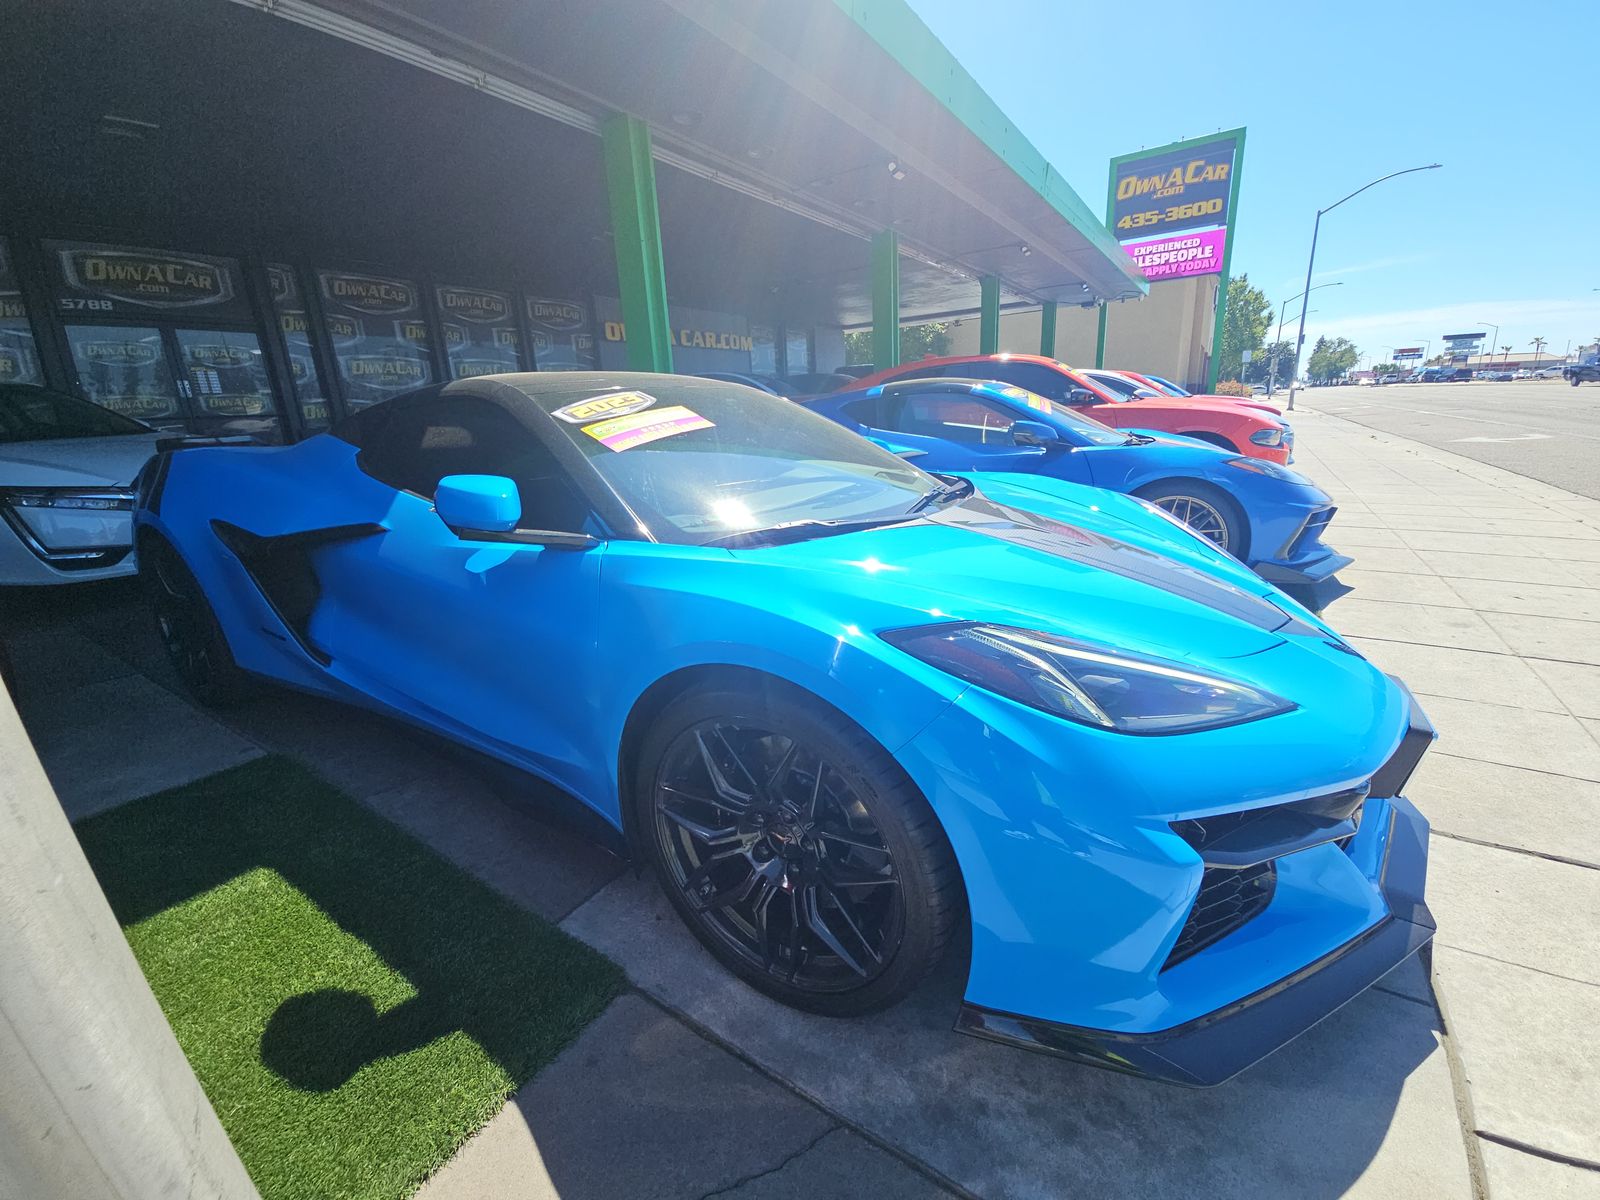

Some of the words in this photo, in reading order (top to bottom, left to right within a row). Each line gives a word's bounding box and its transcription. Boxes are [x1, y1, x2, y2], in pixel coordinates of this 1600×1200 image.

[1154, 184, 1184, 198] .com
[1117, 198, 1223, 229] 435-3600
[1133, 245, 1214, 267] LESPEOPLE
[1134, 238, 1201, 256] EXPERIENCED
[1145, 263, 1179, 276] APPLY
[1181, 257, 1218, 272] TODAY
[136, 282, 170, 293] .com
[61, 298, 113, 311] 5788
[681, 329, 753, 351] CAR.COM
